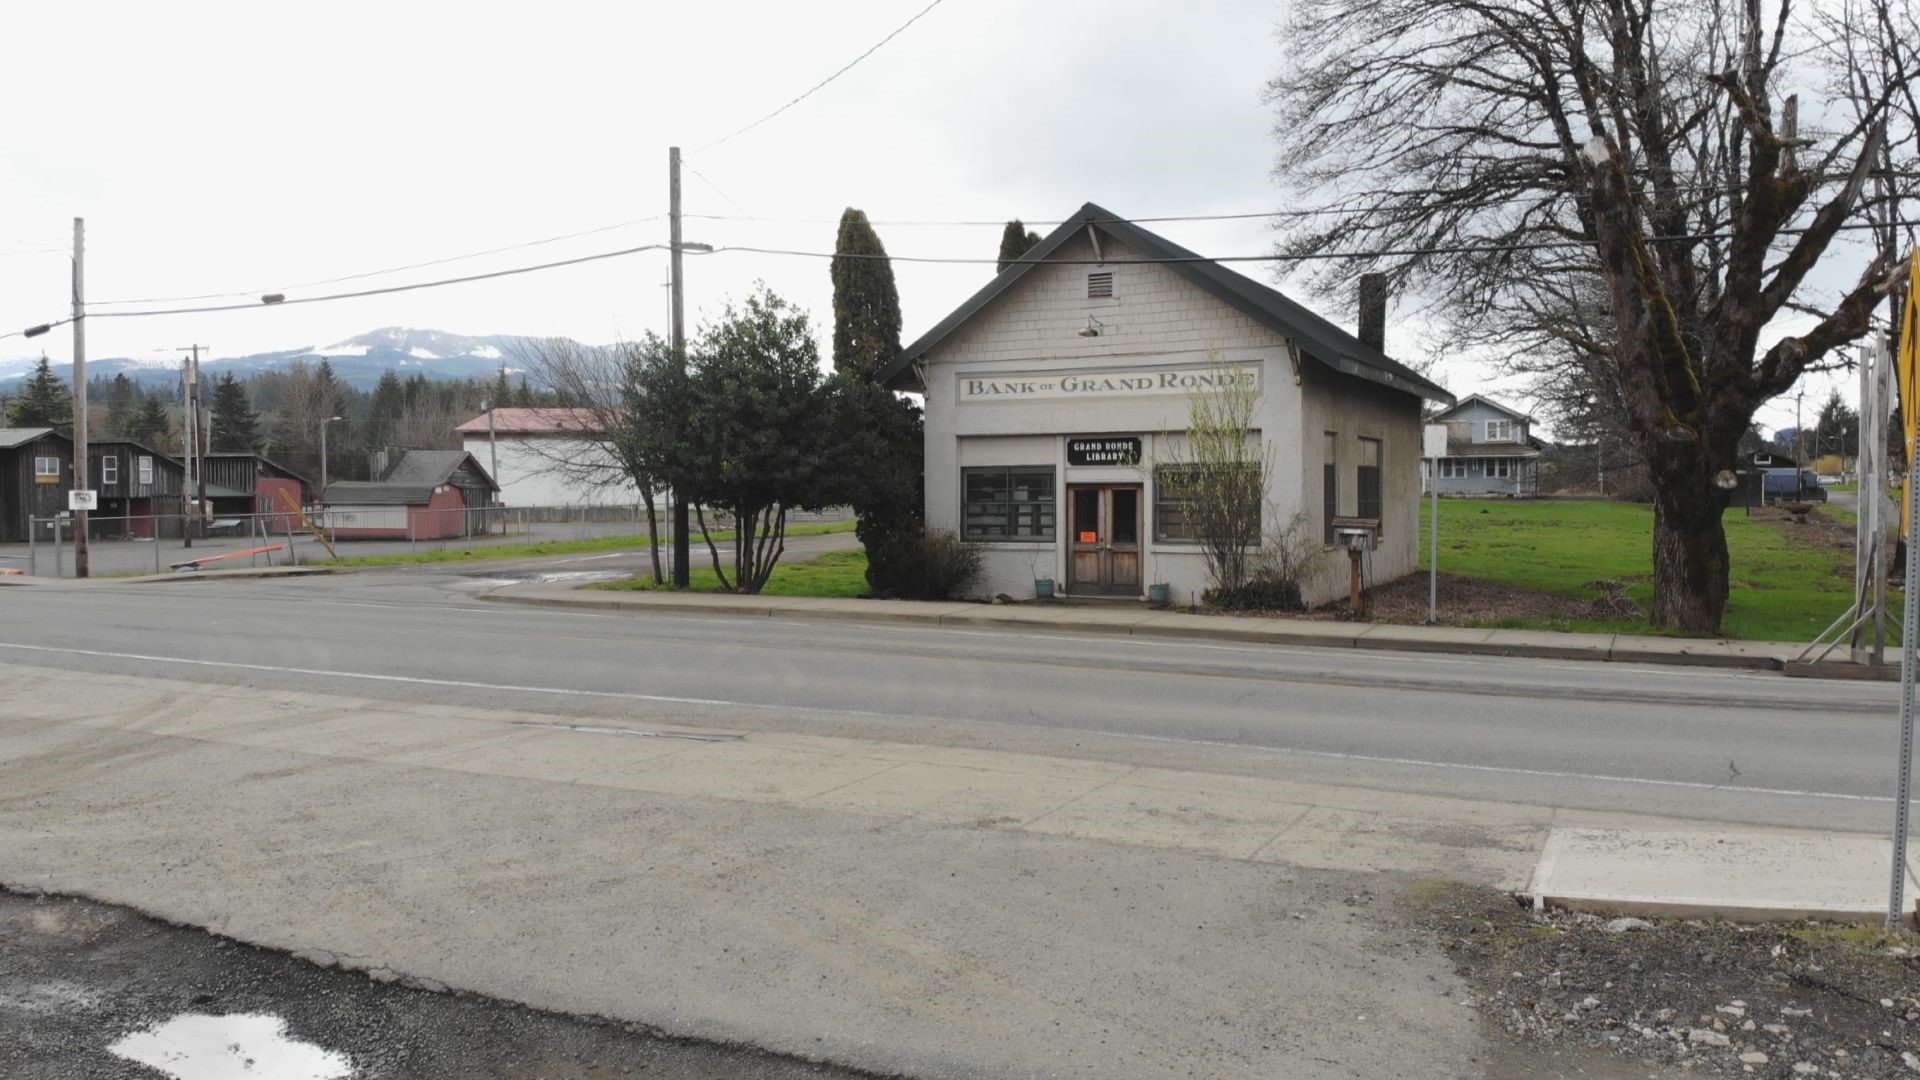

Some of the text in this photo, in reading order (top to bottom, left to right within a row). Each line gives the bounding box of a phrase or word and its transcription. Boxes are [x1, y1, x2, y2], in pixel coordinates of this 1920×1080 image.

[967, 372, 1255, 396] BANK OF GRAND RONDE
[1073, 441, 1134, 451] GRAND RONDE
[1086, 452, 1125, 461] LIBRARY
